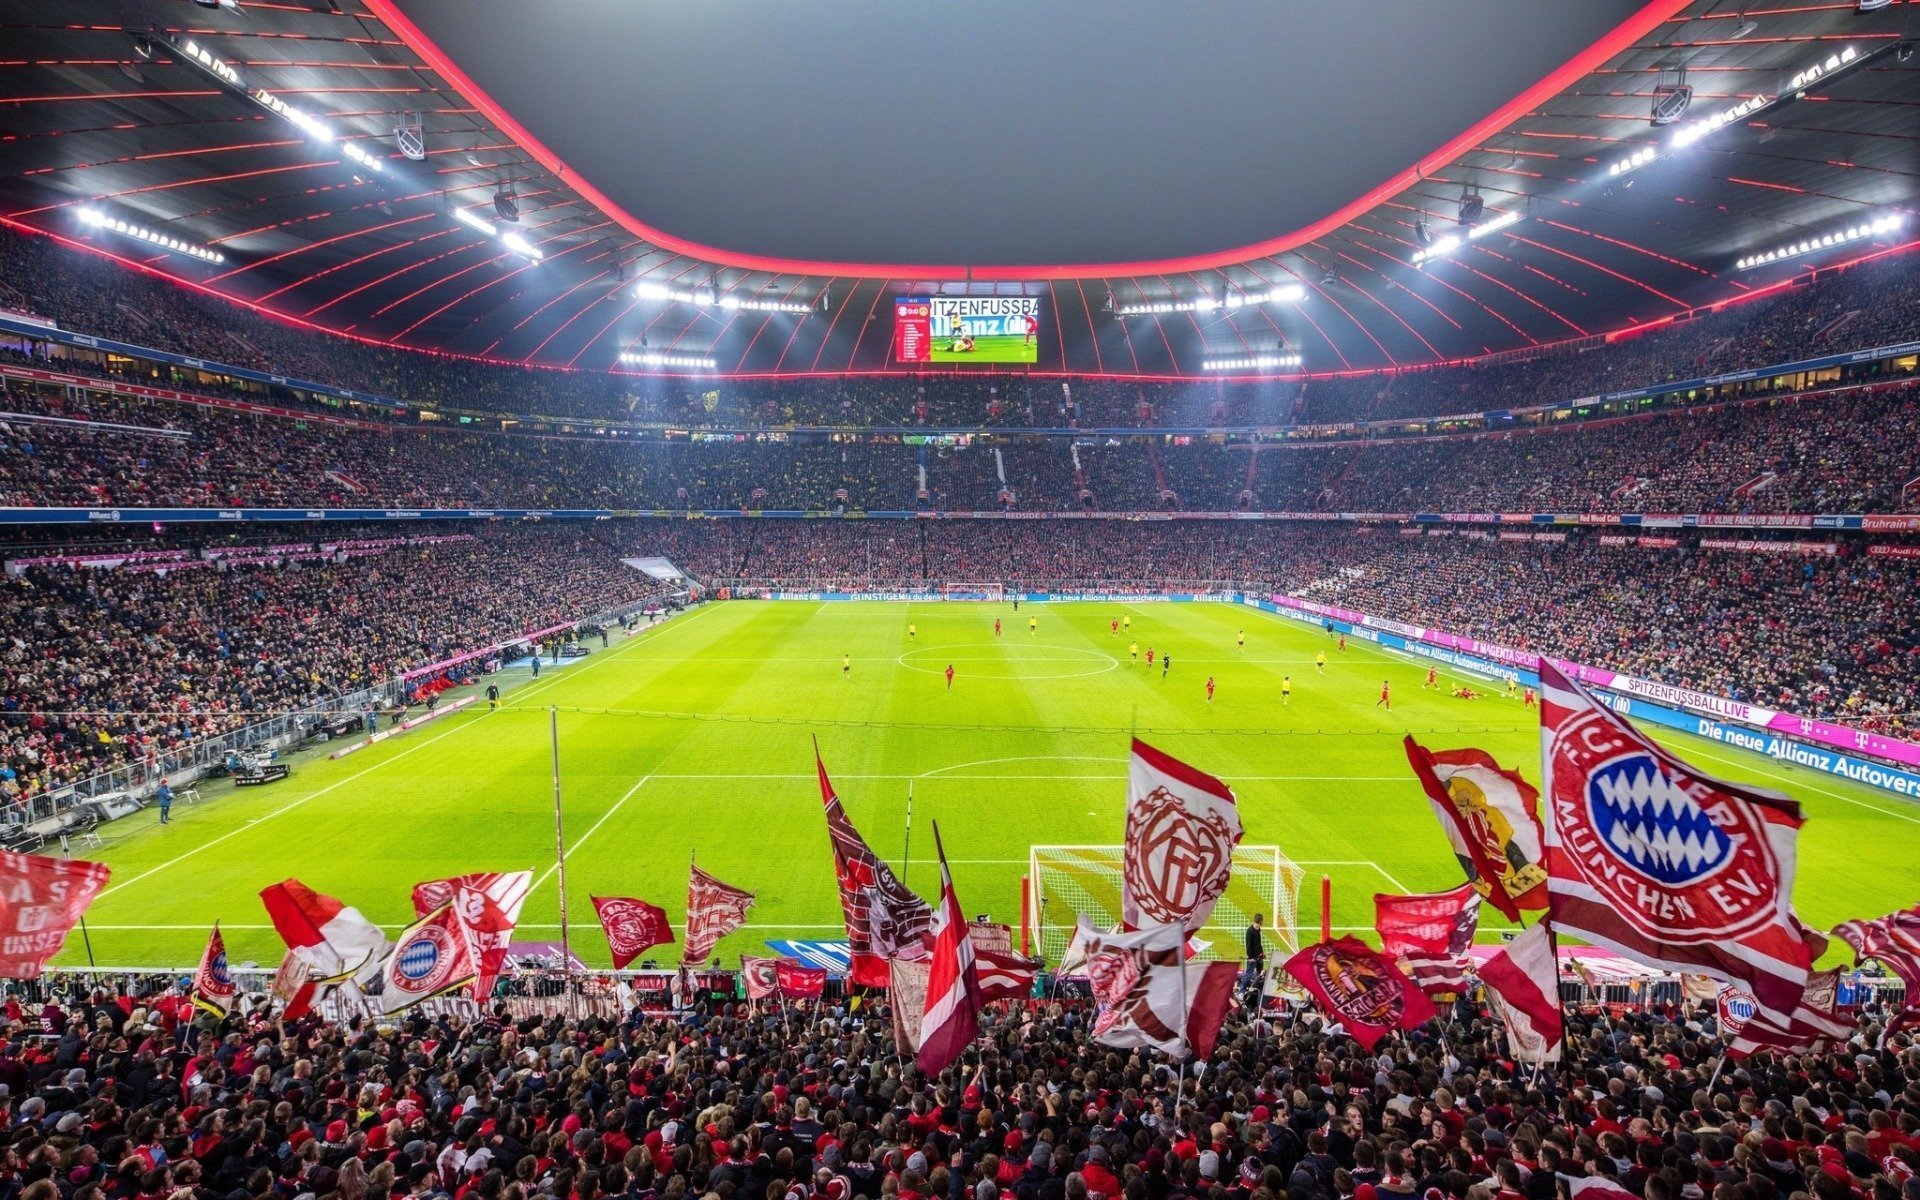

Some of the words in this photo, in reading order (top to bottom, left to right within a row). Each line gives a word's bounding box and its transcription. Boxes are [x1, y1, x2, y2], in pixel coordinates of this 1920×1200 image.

[1852, 351, 1871, 361] Allianz
[1437, 411, 1484, 422] MAINBURG
[1297, 424, 1310, 432] THE
[1310, 423, 1333, 432] FLYING
[1334, 422, 1355, 431] STARS
[88, 511, 112, 520] Allianz
[1580, 514, 1590, 523] Red
[1591, 514, 1606, 523] Wood
[1607, 514, 1621, 523] Cats
[1708, 515, 1714, 525] 1.
[1714, 515, 1734, 525] OLDIE
[1734, 515, 1767, 525] FANCLUB
[1767, 515, 1786, 525] 2000
[1813, 517, 1836, 526] Allianz
[1862, 516, 1907, 529] Bruhrain
[1736, 540, 1754, 549] RED
[1754, 541, 1791, 551] POWER
[1891, 546, 1911, 555] Audi
[779, 593, 809, 601] Allianz
[1193, 594, 1222, 602] Allianz
[1351, 625, 1371, 639] Allianz
[1406, 624, 1417, 636] LIVE
[1480, 642, 1514, 662] MAGENTA
[1515, 651, 1540, 667] SPORT
[1404, 640, 1414, 651] Die
[1415, 643, 1430, 656] neue
[1431, 648, 1452, 663] Allianz
[1454, 654, 1520, 682] Autoversicherung.
[1629, 678, 1724, 713] SPITZENFUSSBALL
[1723, 701, 1750, 719] LIVE
[1698, 719, 1722, 740] Die
[1725, 730, 1764, 751] neue
[1766, 739, 1830, 771] Allianz
[1556, 800, 1697, 921] MÜNCHEN
[1706, 868, 1769, 916] E.V.
